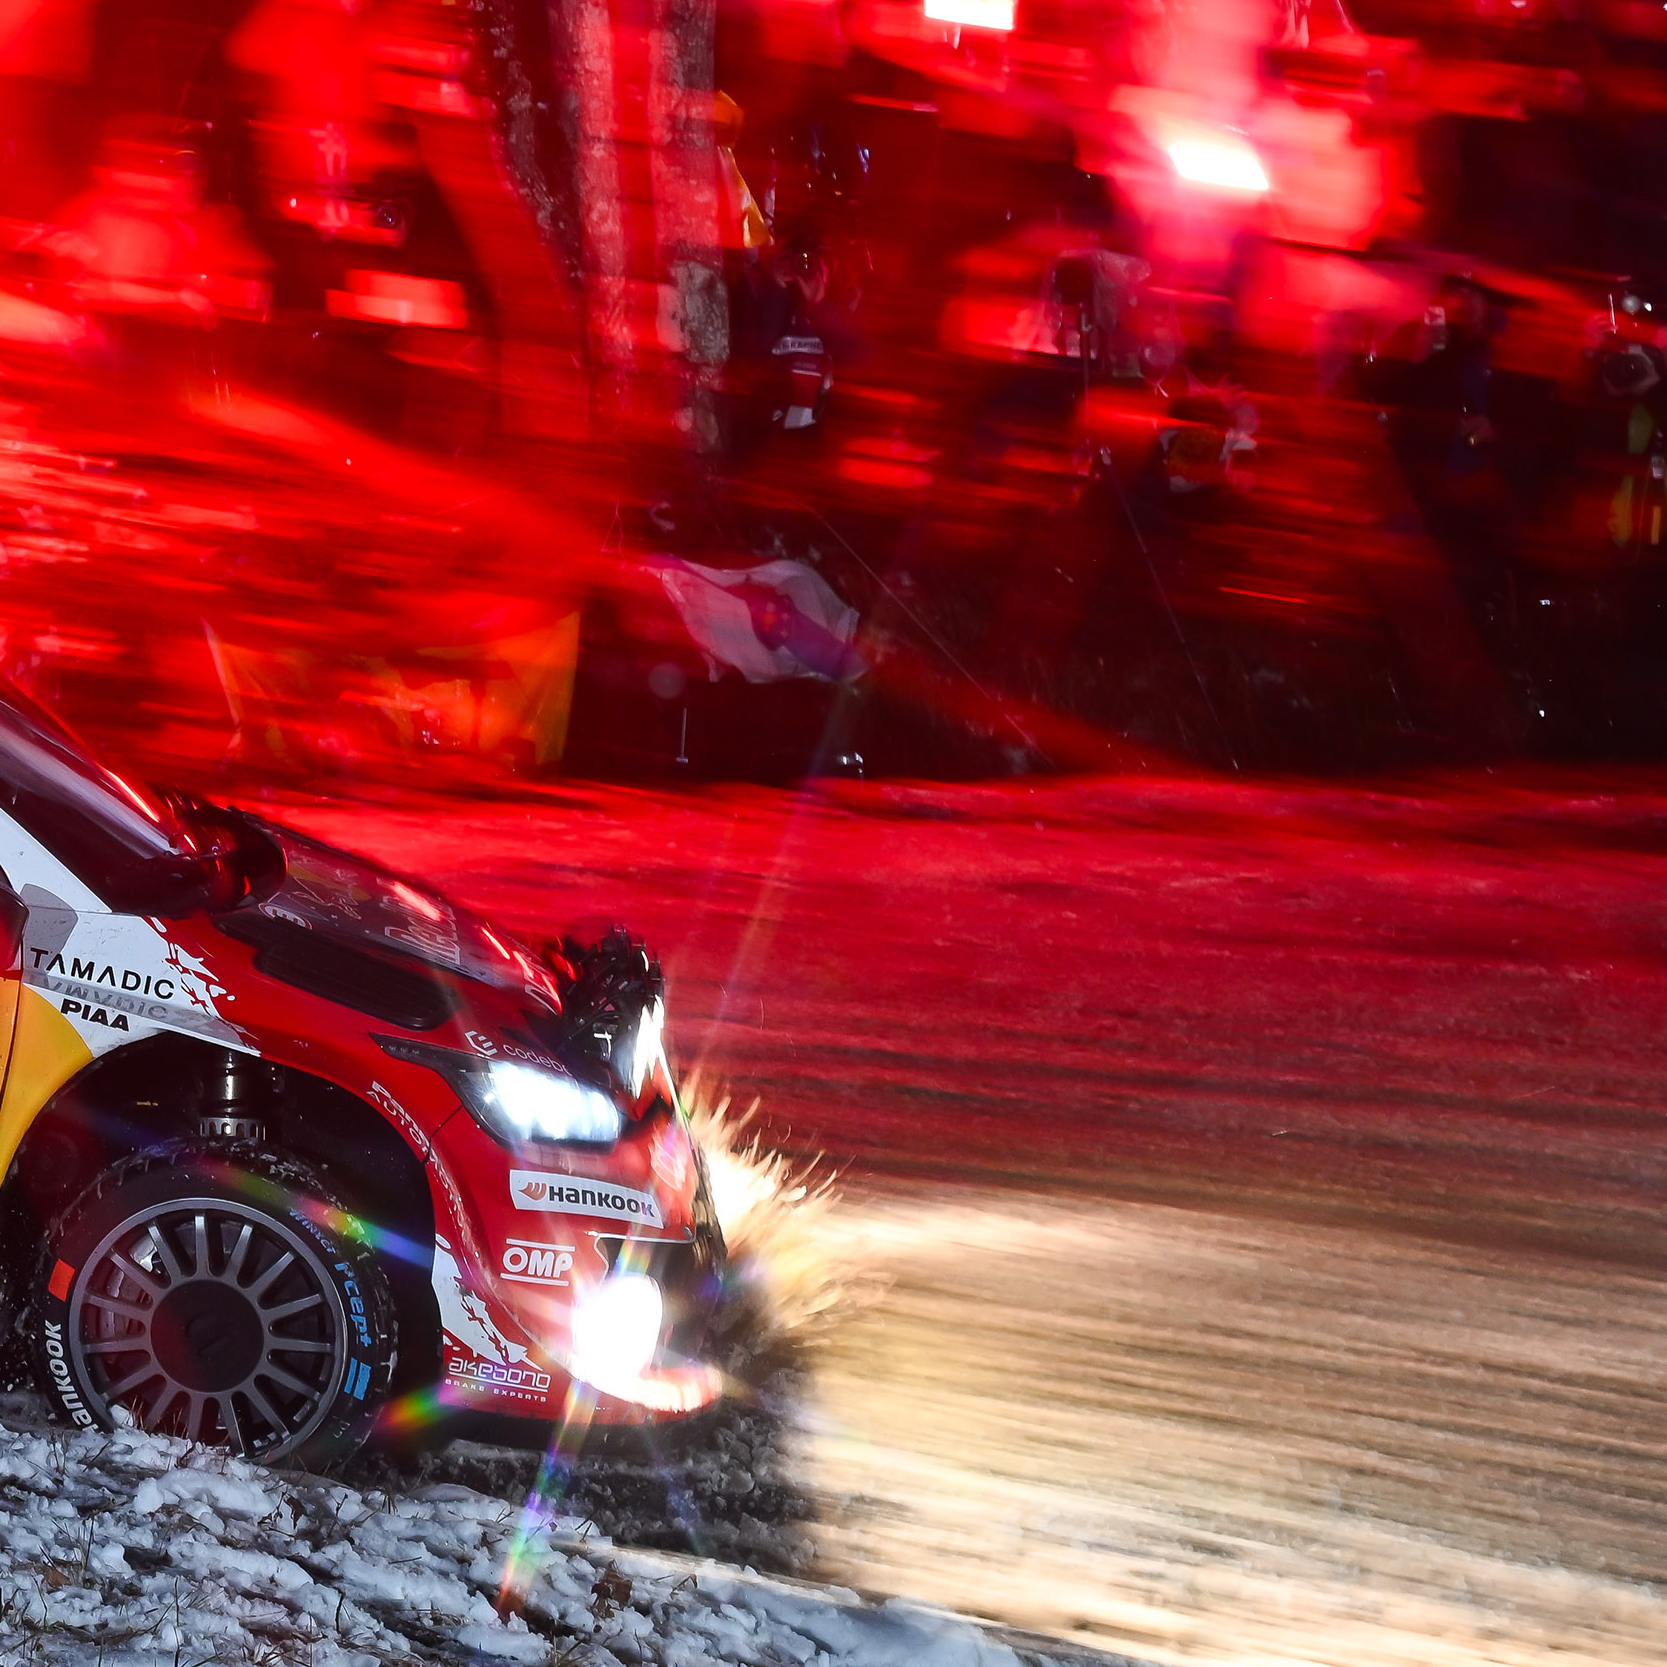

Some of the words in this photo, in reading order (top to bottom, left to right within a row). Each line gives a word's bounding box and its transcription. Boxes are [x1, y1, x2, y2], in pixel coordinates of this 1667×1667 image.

[30, 947, 174, 1000] TAMADIC
[60, 998, 129, 1032] PIAA
[502, 1247, 573, 1278] OMP
[445, 1378, 485, 1392] BRAKE
[493, 1388, 547, 1403] EXPERTS
